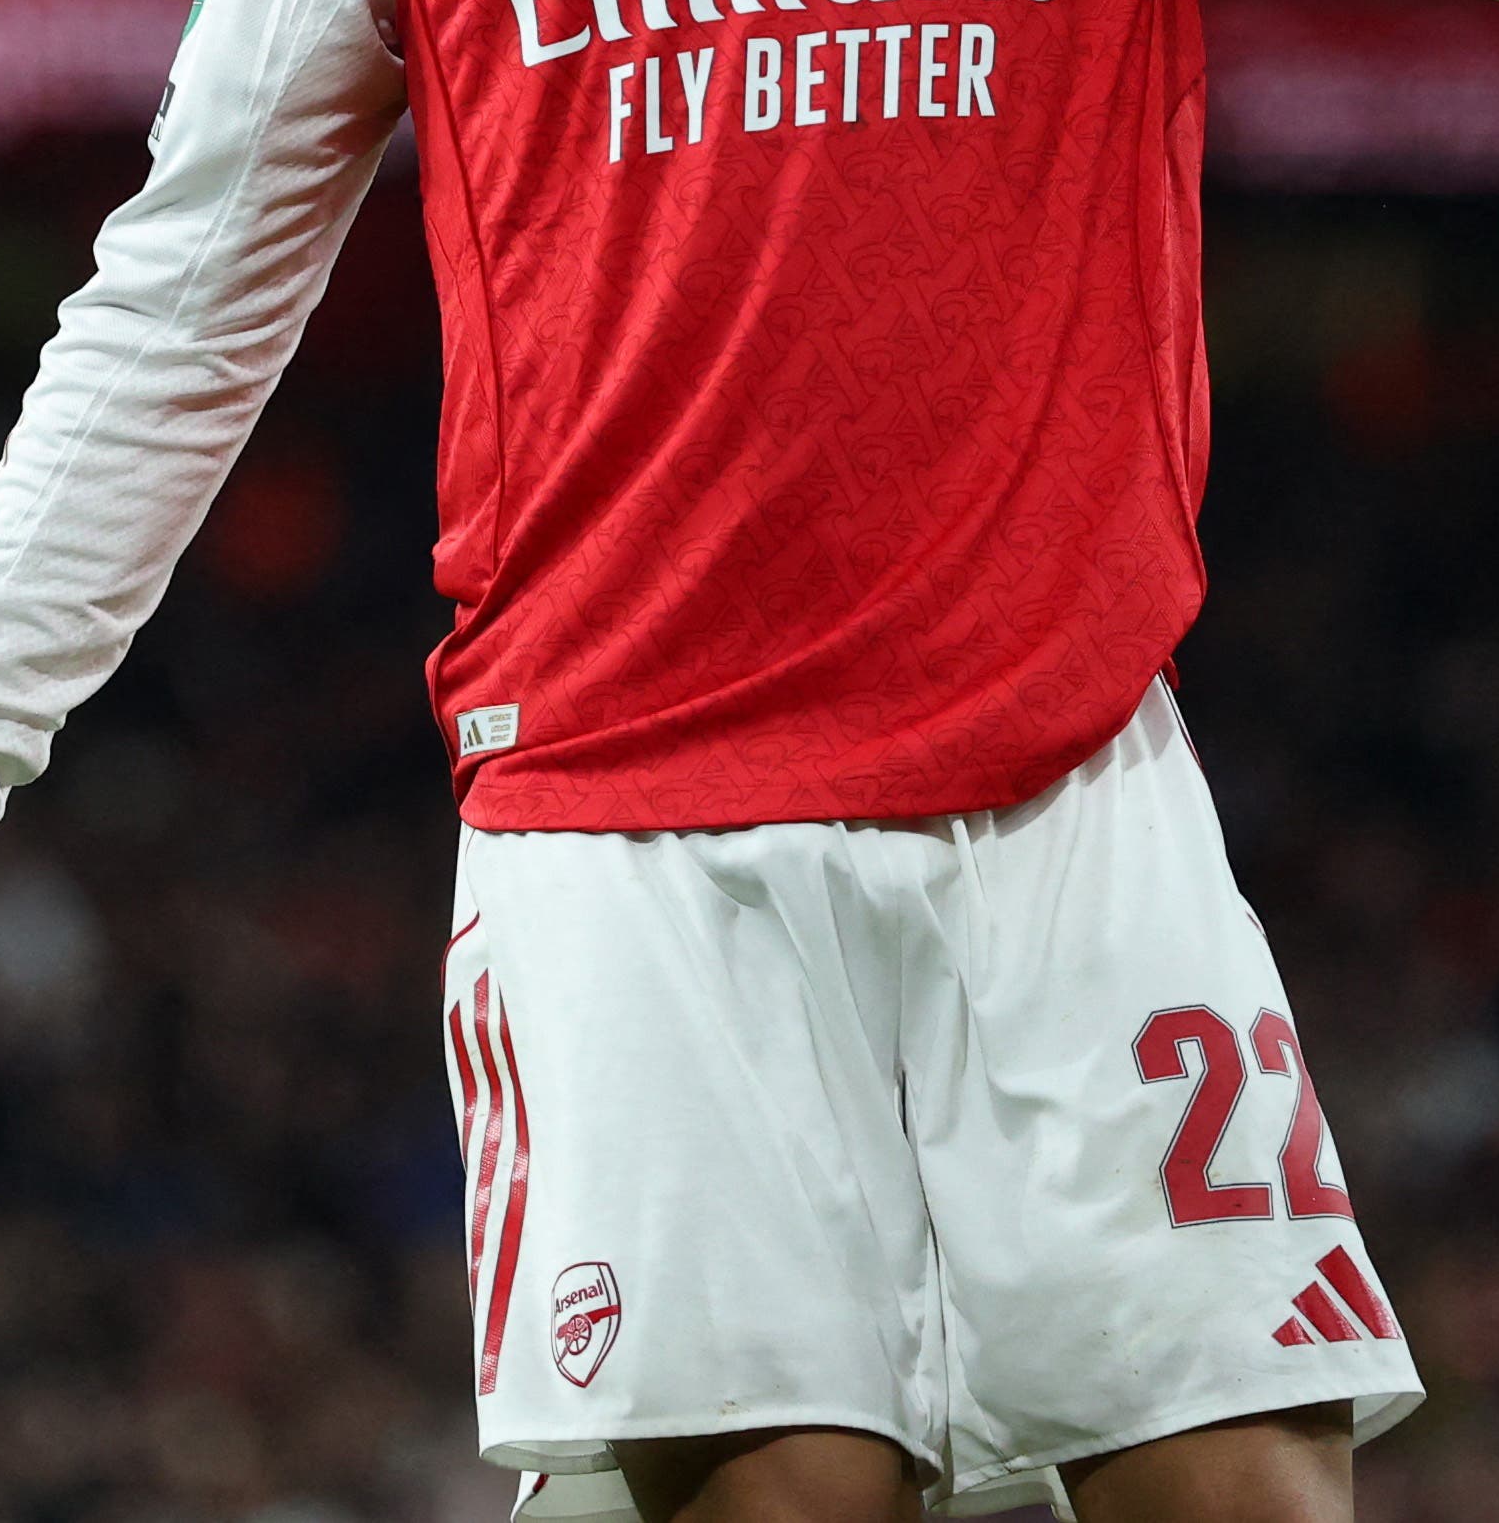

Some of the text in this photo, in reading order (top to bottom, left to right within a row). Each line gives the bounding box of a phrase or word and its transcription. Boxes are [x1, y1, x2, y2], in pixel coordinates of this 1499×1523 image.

[608, 23, 996, 164] FLY BETTER
[1131, 1003, 1355, 1230] 22
[555, 1278, 604, 1314] Arsenal
